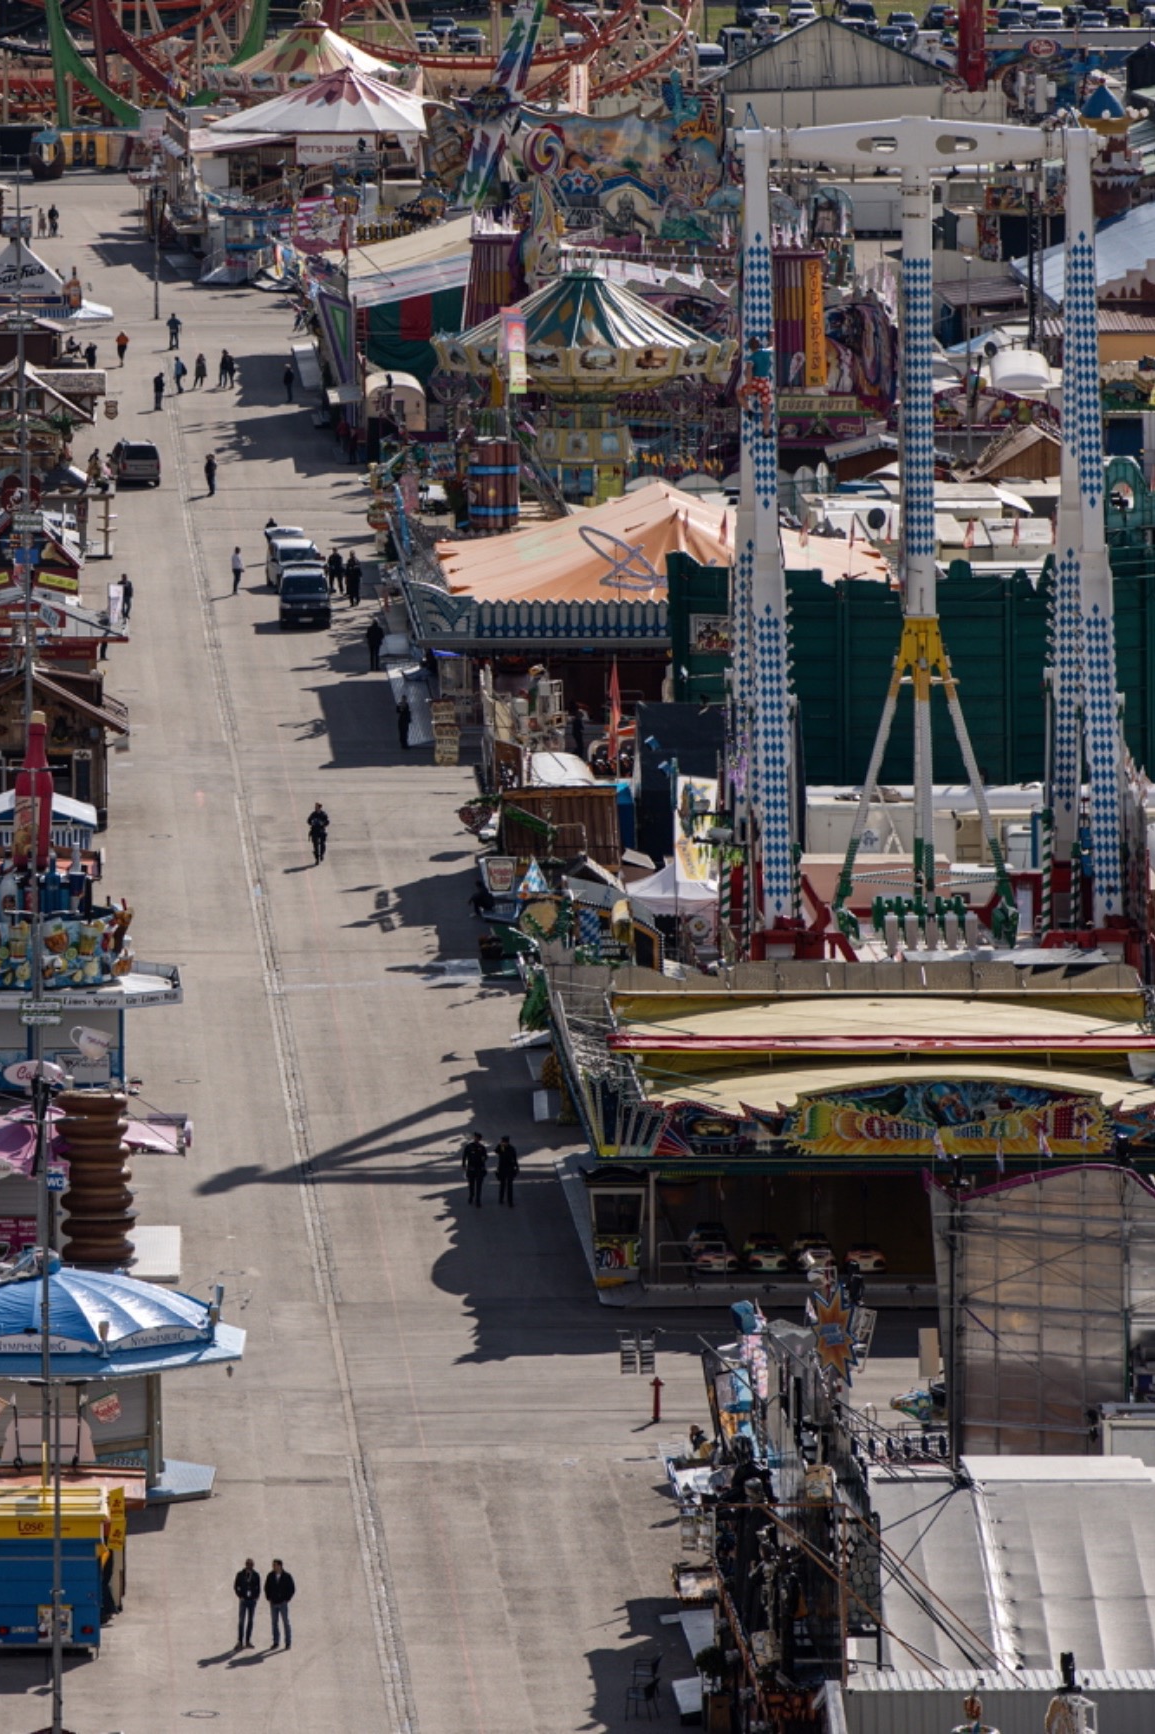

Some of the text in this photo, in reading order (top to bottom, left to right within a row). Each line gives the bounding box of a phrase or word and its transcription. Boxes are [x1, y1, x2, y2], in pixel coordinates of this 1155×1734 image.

[780, 398, 854, 410] SÜSSE HÜTTE
[46, 1177, 64, 1188] WC
[130, 1329, 186, 1347] NYMPHENBURG
[18, 1520, 44, 1533] Lose
